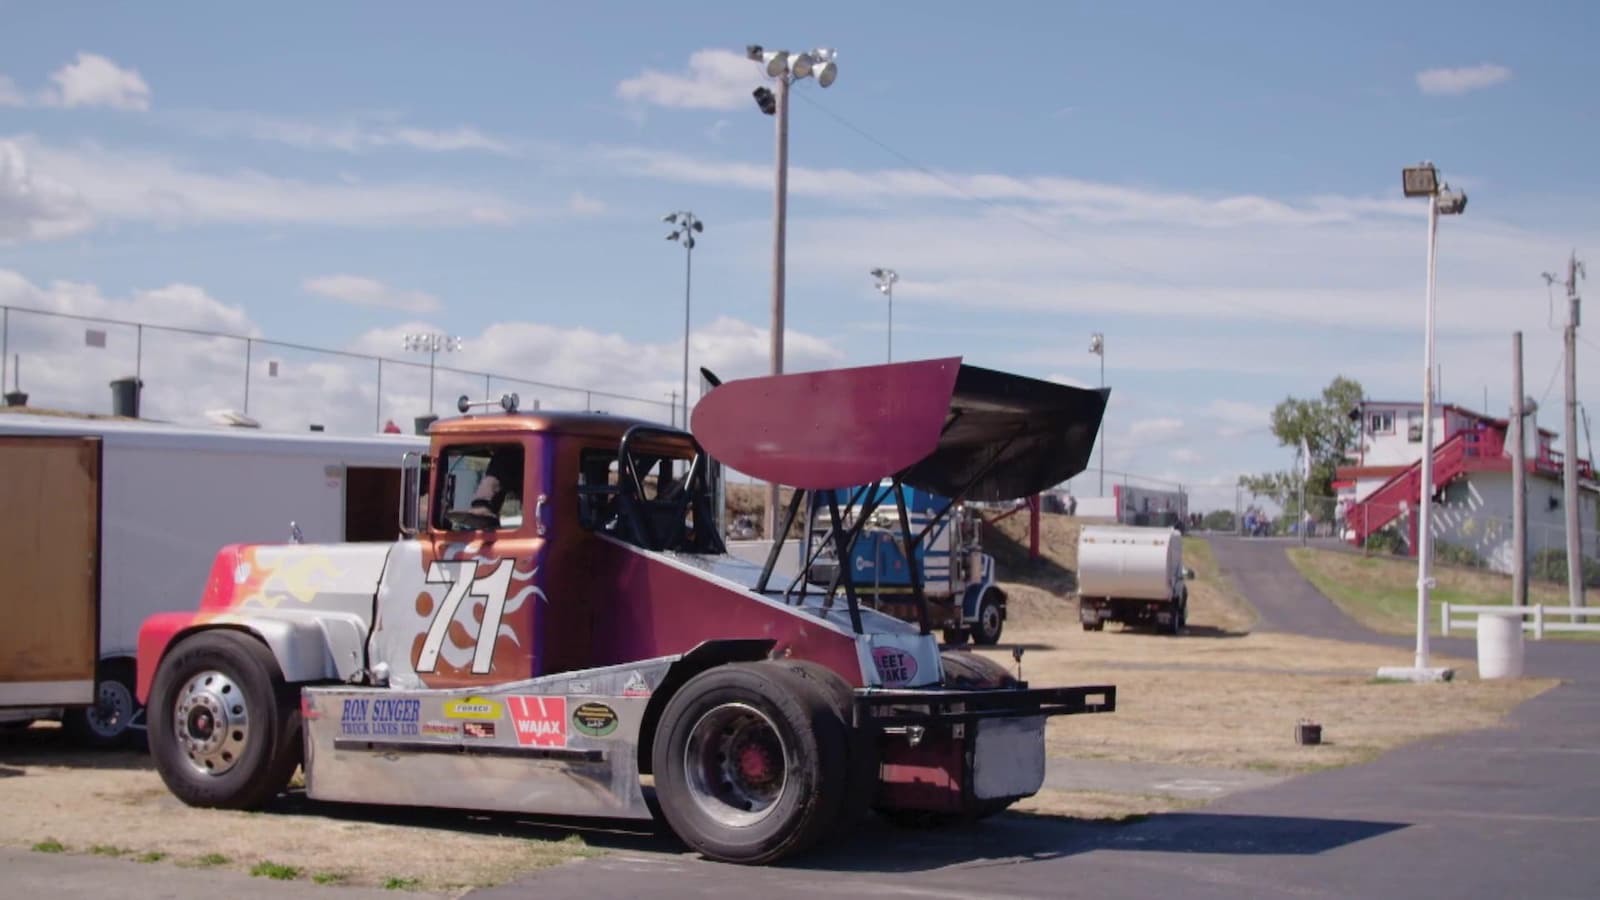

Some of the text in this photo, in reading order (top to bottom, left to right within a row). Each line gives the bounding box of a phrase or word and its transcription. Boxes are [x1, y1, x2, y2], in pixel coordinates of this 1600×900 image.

[415, 558, 516, 675] 71
[342, 699, 420, 722] RON SINGER
[342, 723, 369, 735] TRUCK
[373, 723, 398, 736] LINES
[519, 719, 560, 737] WAJAX
